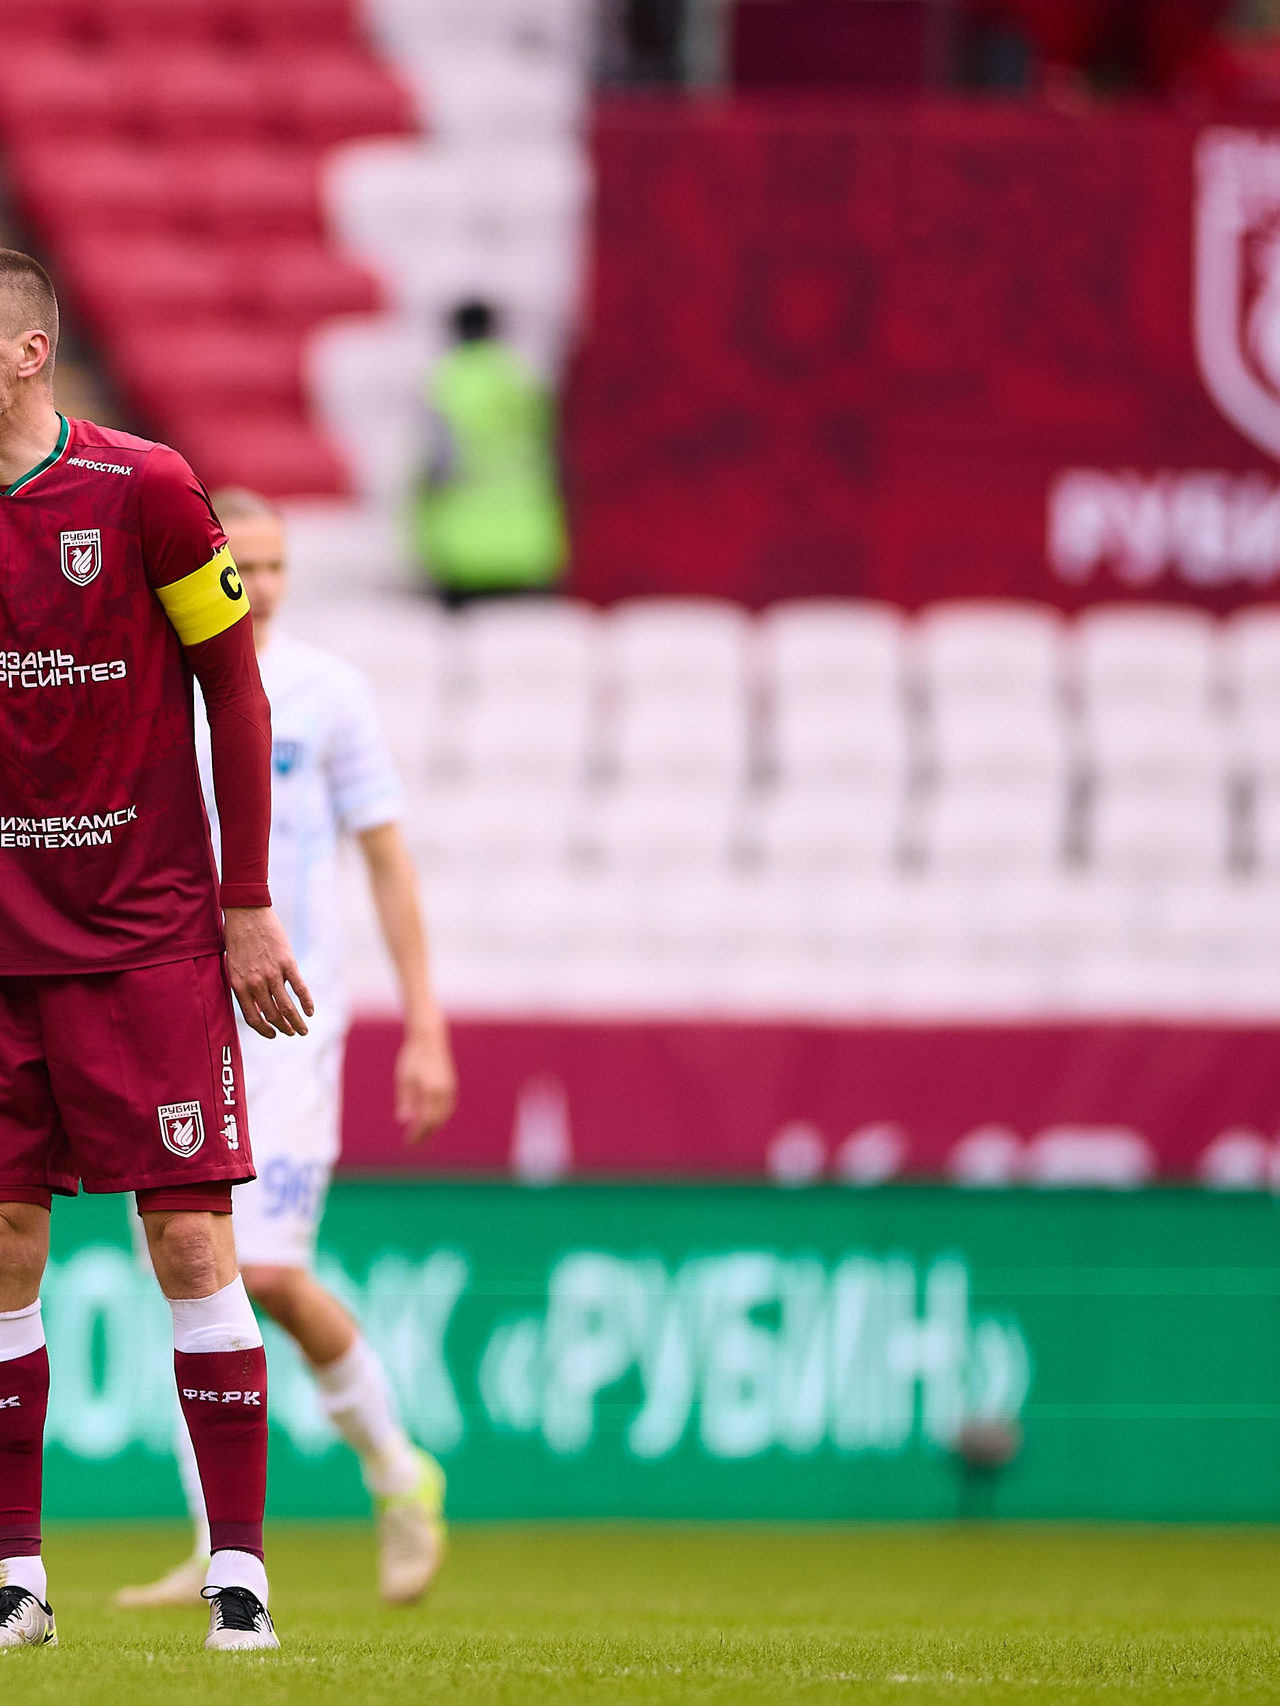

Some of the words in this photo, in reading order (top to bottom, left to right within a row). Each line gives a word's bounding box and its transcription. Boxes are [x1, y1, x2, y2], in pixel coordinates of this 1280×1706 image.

[67, 457, 133, 476] ИНГОССТРАХ
[62, 531, 99, 541] РУБИН
[220, 566, 243, 600] C
[160, 1103, 198, 1115] РУБИН
